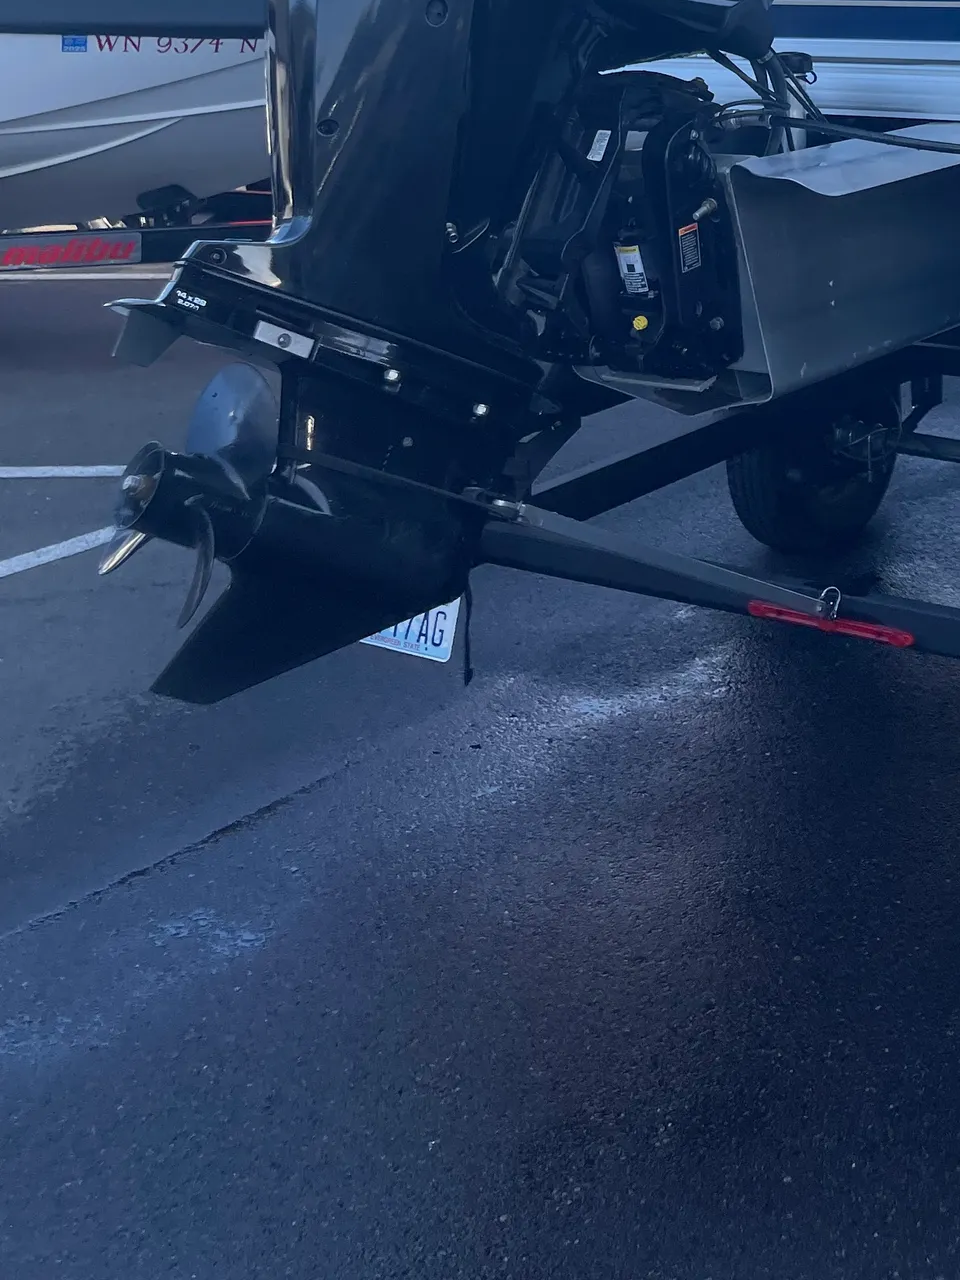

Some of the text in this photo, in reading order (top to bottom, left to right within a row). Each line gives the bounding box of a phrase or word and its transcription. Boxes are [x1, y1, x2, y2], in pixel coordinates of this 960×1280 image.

[95, 35, 141, 52] WN
[2, 237, 136, 265] malibu
[403, 641, 420, 651] STATE
